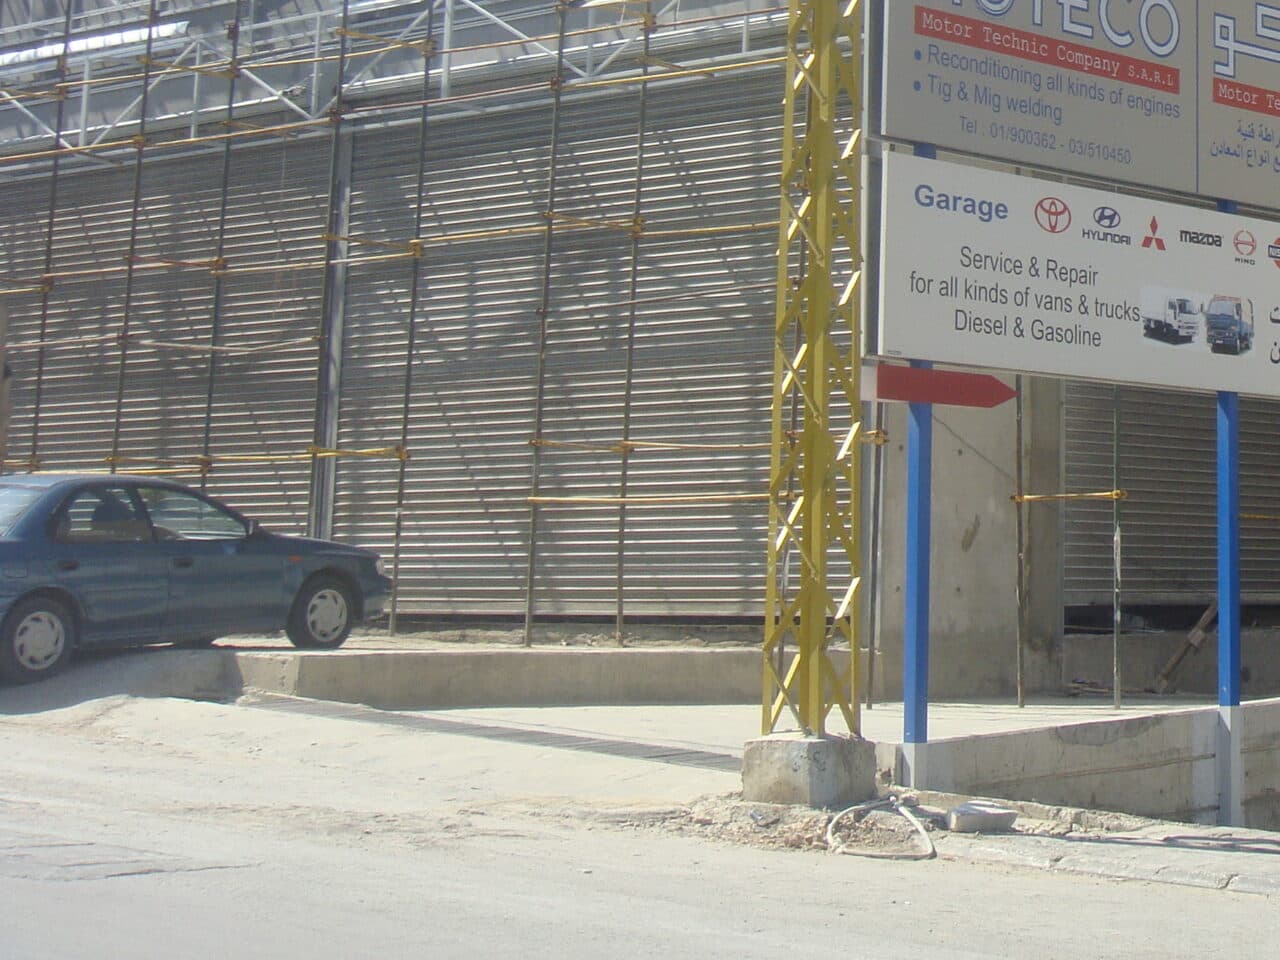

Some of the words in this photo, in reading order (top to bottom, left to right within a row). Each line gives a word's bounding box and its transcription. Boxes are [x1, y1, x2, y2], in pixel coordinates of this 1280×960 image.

[922, 11, 972, 39] Motor
[983, 25, 1048, 58] Technic
[1056, 44, 1120, 78] Company
[927, 42, 1041, 92] Reconditioning
[1047, 68, 1065, 91] all
[1068, 73, 1105, 103] kinds
[1109, 85, 1123, 105] of
[1127, 94, 1181, 119] engines
[927, 74, 951, 103] Tig
[957, 83, 969, 102] &
[974, 85, 1001, 113] Mig
[1006, 94, 1063, 126] welding
[1218, 83, 1258, 106] Motor
[960, 115, 977, 134] Tel
[990, 122, 1056, 150] 01/900362
[914, 184, 1009, 223] Garage
[1082, 228, 1131, 246] HYUNDAI
[960, 246, 1023, 276] Service
[1028, 256, 1040, 278] &
[1046, 259, 1099, 287] Repair
[1234, 257, 1256, 266] HINO
[909, 271, 933, 294] for
[938, 276, 958, 298] all
[964, 278, 1008, 305] kinds
[1014, 287, 1030, 307] of
[1034, 295, 1073, 314] vans
[1078, 294, 1090, 316] &
[1095, 297, 1141, 323] trucks
[954, 309, 1008, 336] Diesel
[1013, 317, 1025, 338] &
[1031, 319, 1102, 347] Gasoline
